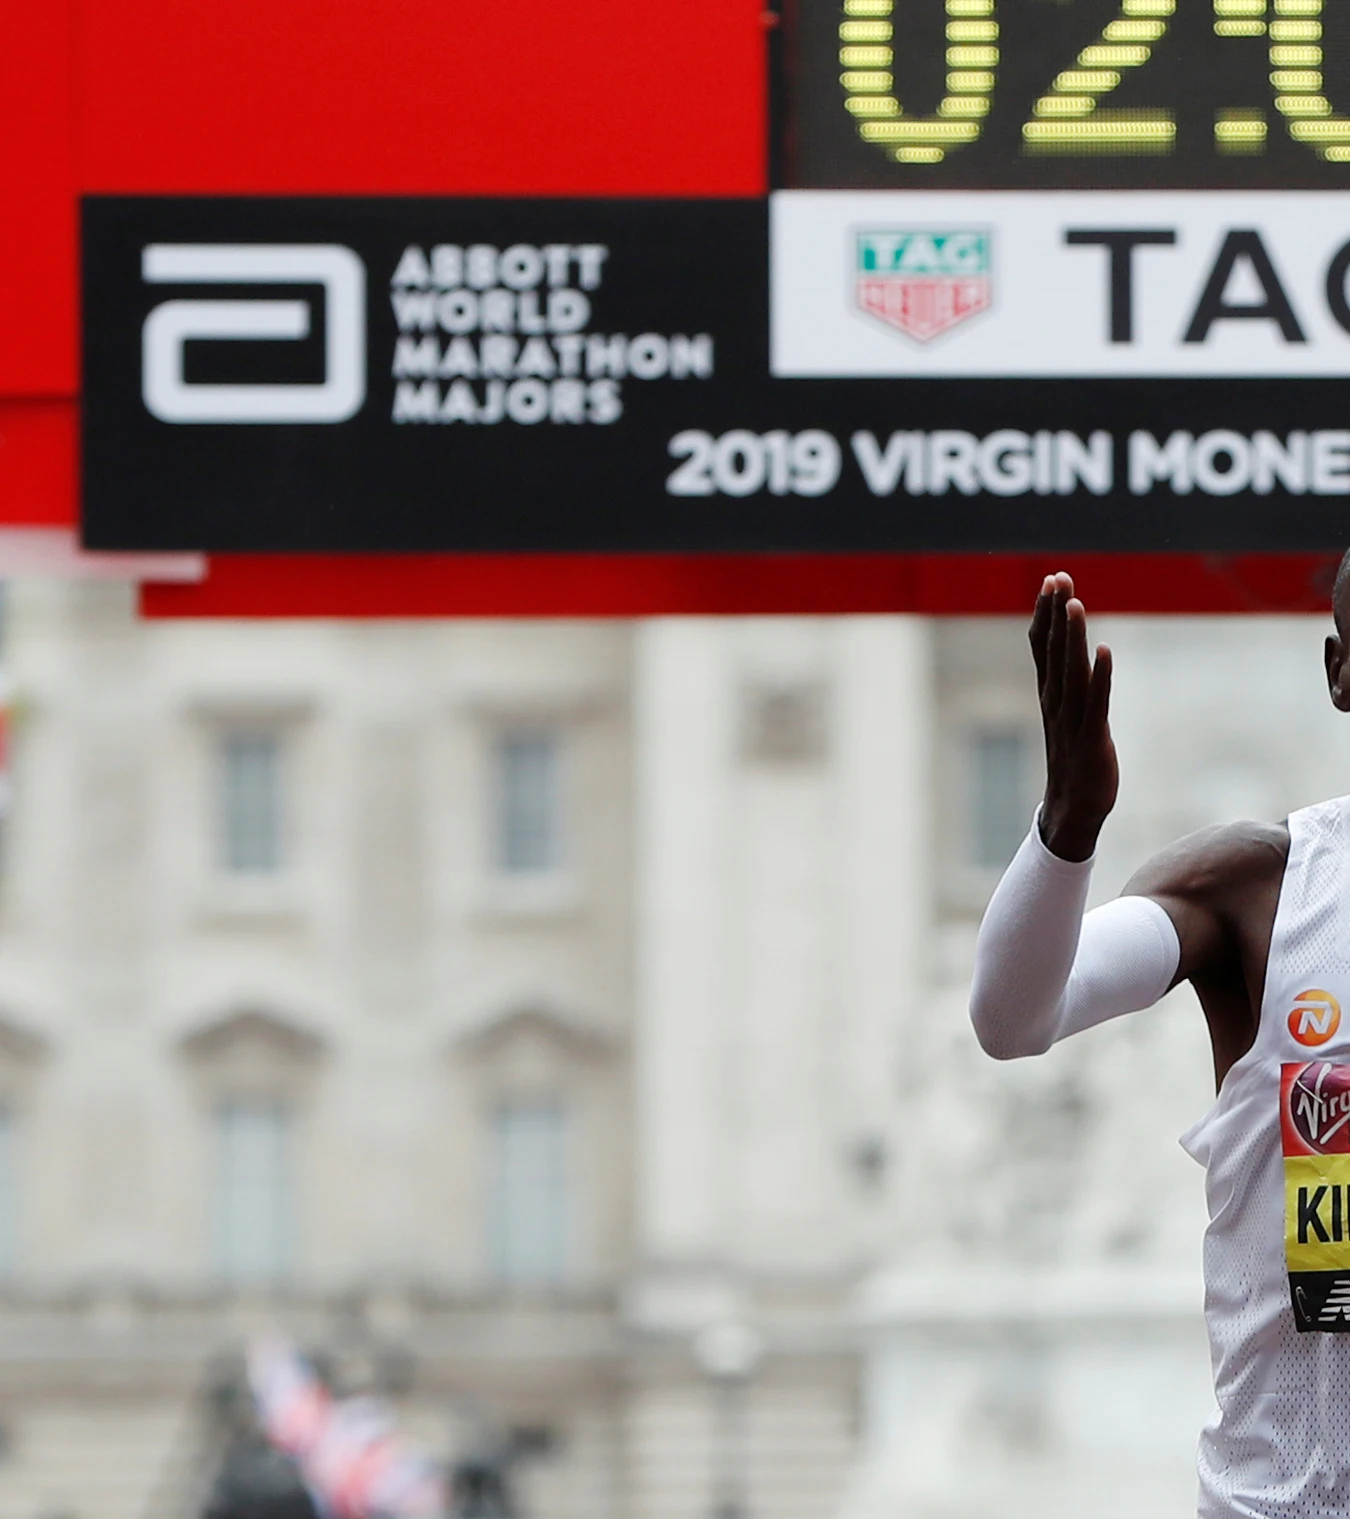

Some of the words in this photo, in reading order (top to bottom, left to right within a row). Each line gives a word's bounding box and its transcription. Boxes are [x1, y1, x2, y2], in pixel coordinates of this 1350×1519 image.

[392, 244, 606, 289] ABBOTT
[392, 290, 590, 334] WORLD
[392, 334, 713, 379] MARATHON
[392, 379, 622, 425] MAJORS
[667, 430, 840, 495] 2019
[852, 430, 1112, 495] VIRGIN
